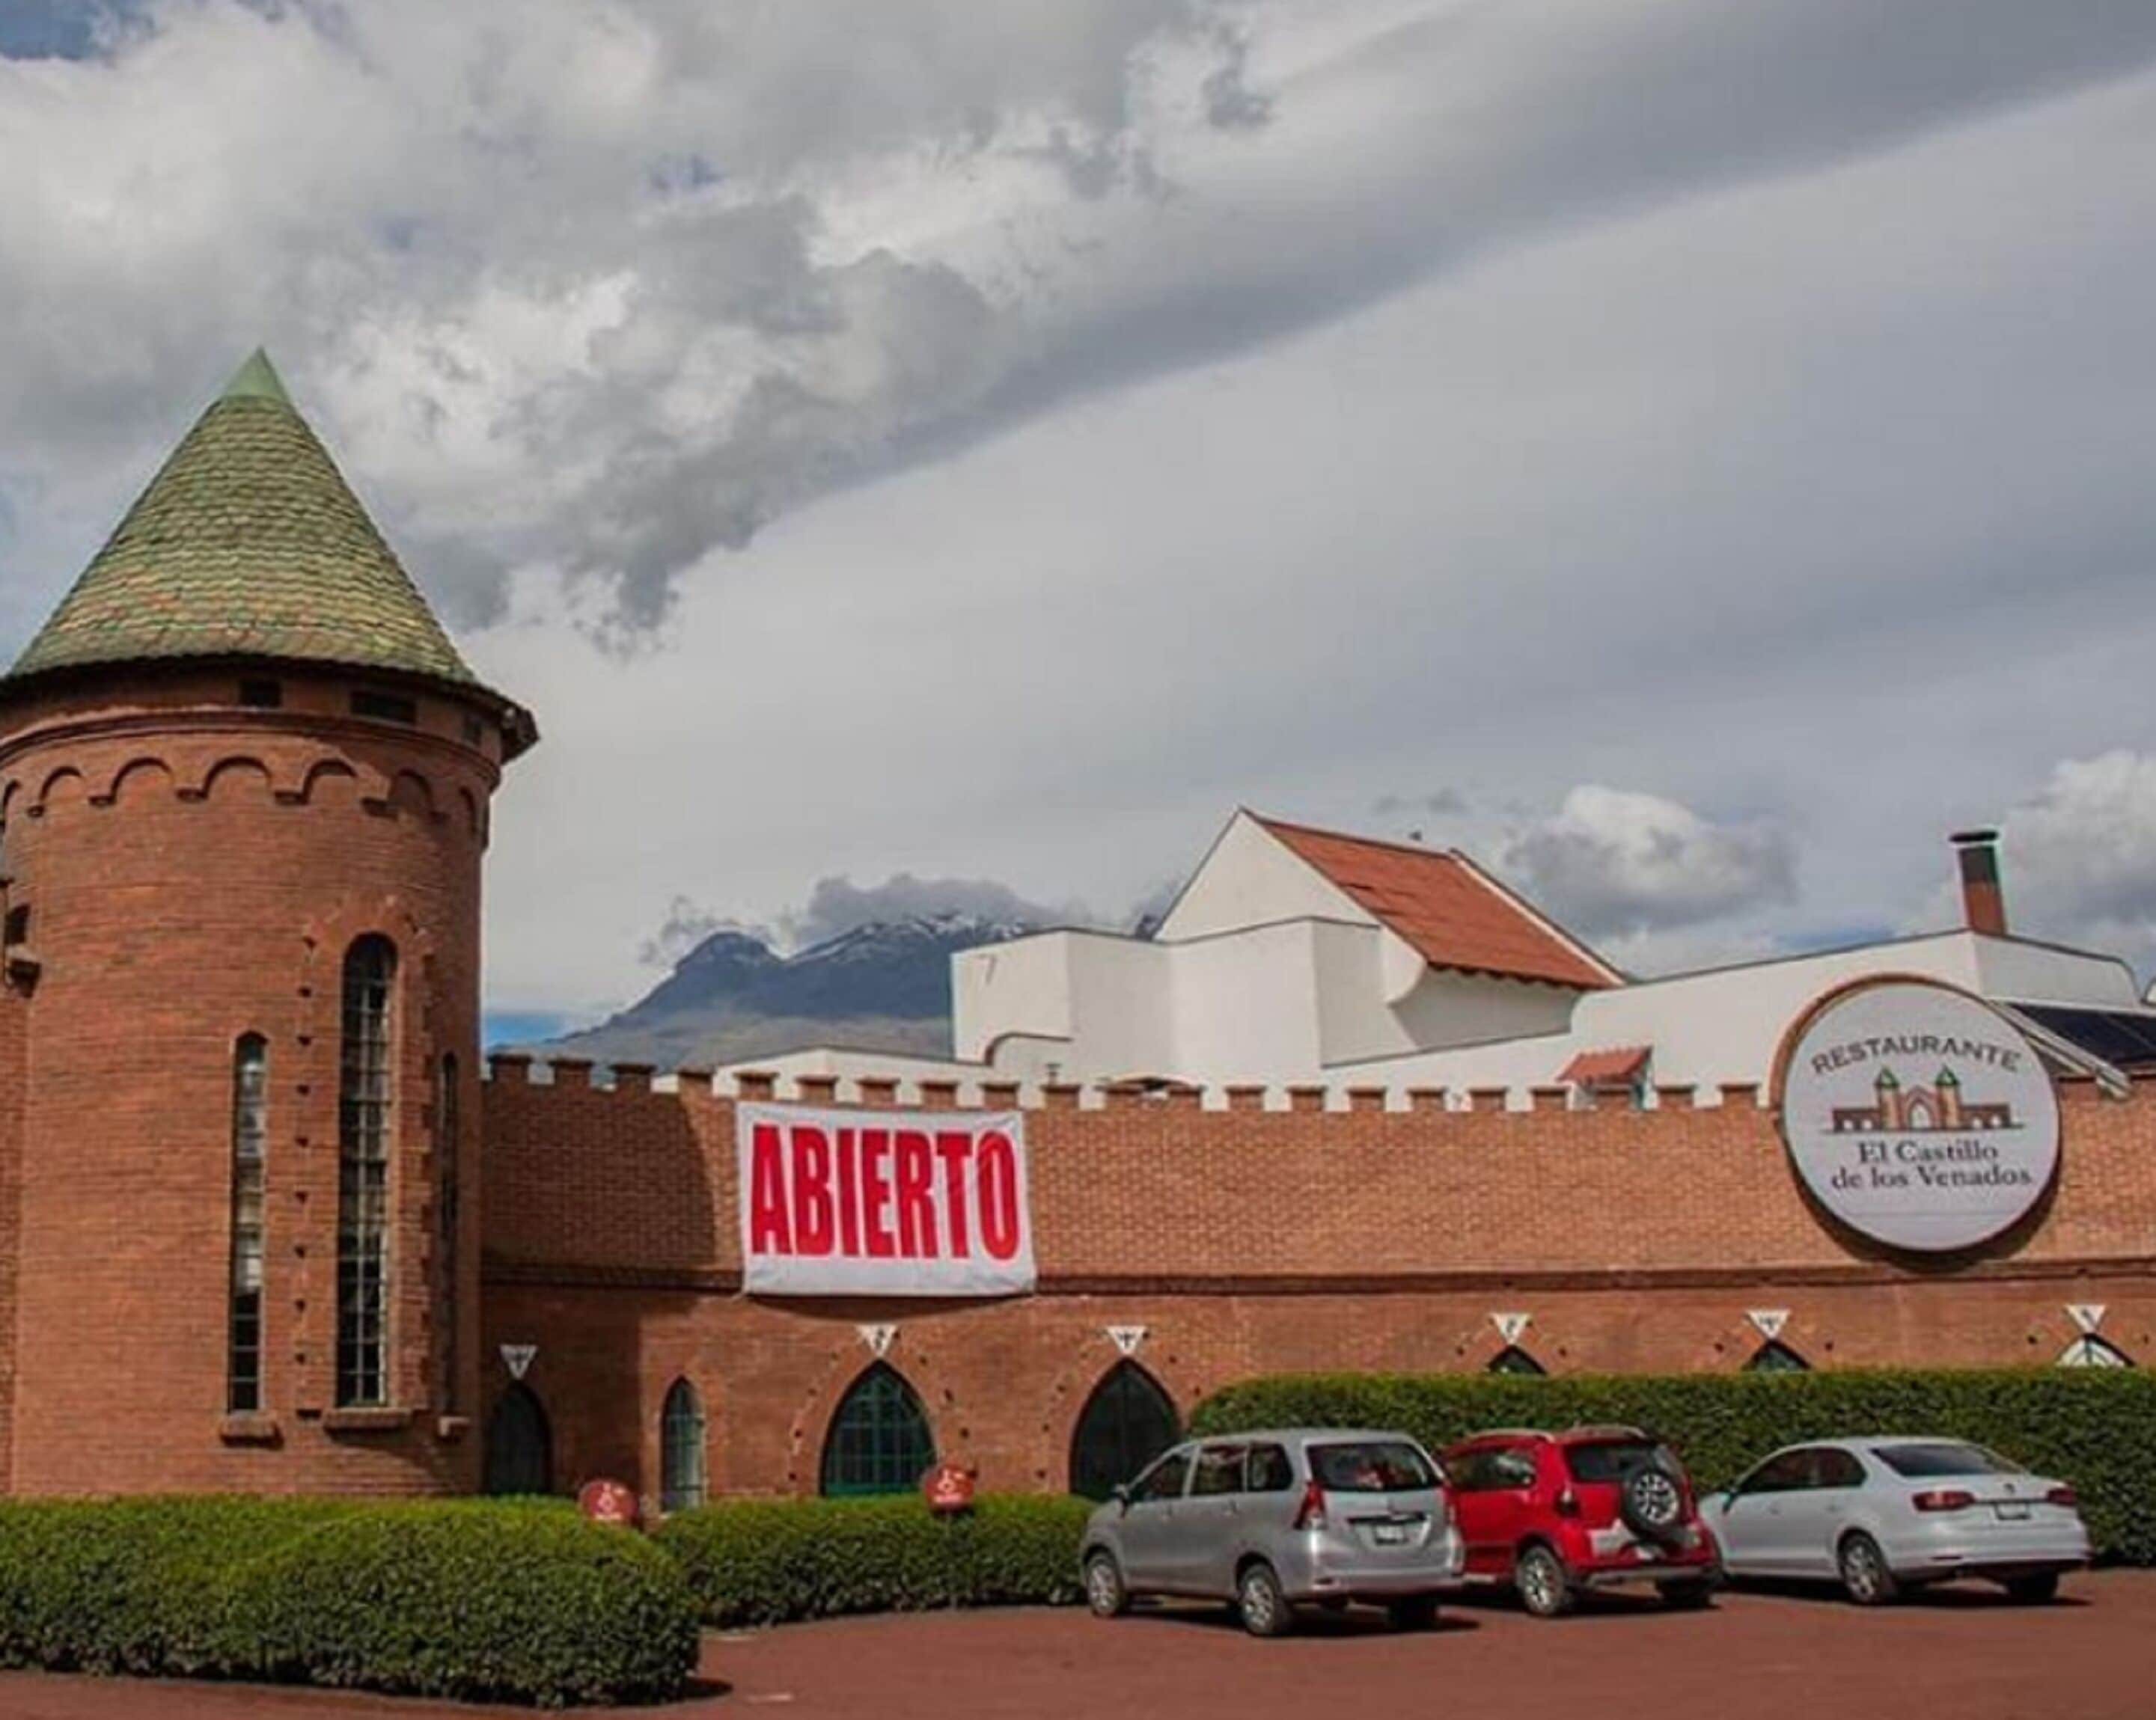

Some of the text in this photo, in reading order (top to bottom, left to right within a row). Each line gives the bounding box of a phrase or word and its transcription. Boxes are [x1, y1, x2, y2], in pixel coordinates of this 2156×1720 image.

[1811, 1035, 2021, 1074] RESTAURANTE
[1858, 1139, 1999, 1164] El Castillo
[751, 1124, 1019, 1260] ABIERTO
[1831, 1162, 2031, 1189] de los Venados
